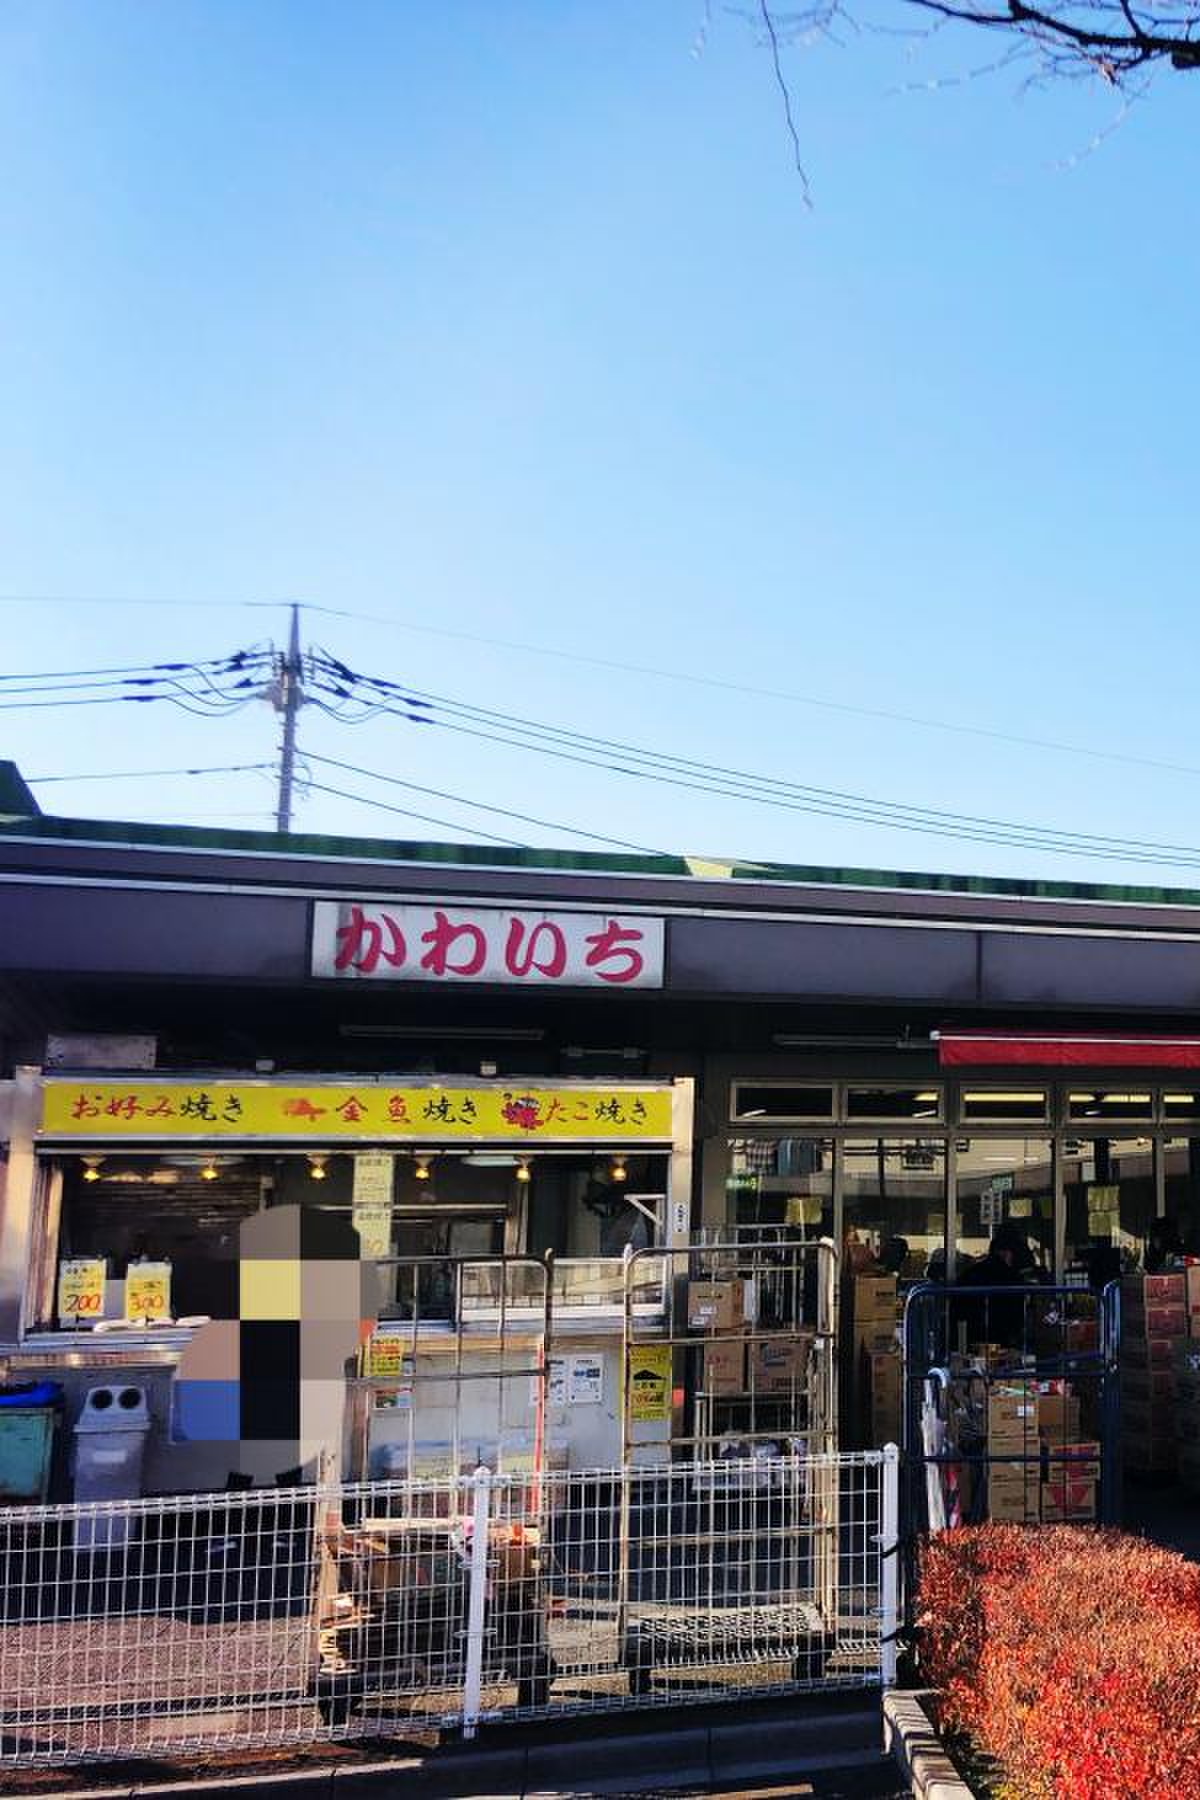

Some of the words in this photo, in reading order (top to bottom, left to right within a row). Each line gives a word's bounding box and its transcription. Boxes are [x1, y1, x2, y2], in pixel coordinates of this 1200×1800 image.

[334, 906, 644, 983] かわいち
[71, 1093, 243, 1123] お好み焼き
[335, 1094, 478, 1125] 金魚焼き
[545, 1096, 647, 1125] たこ焼き
[65, 1294, 101, 1312] 200
